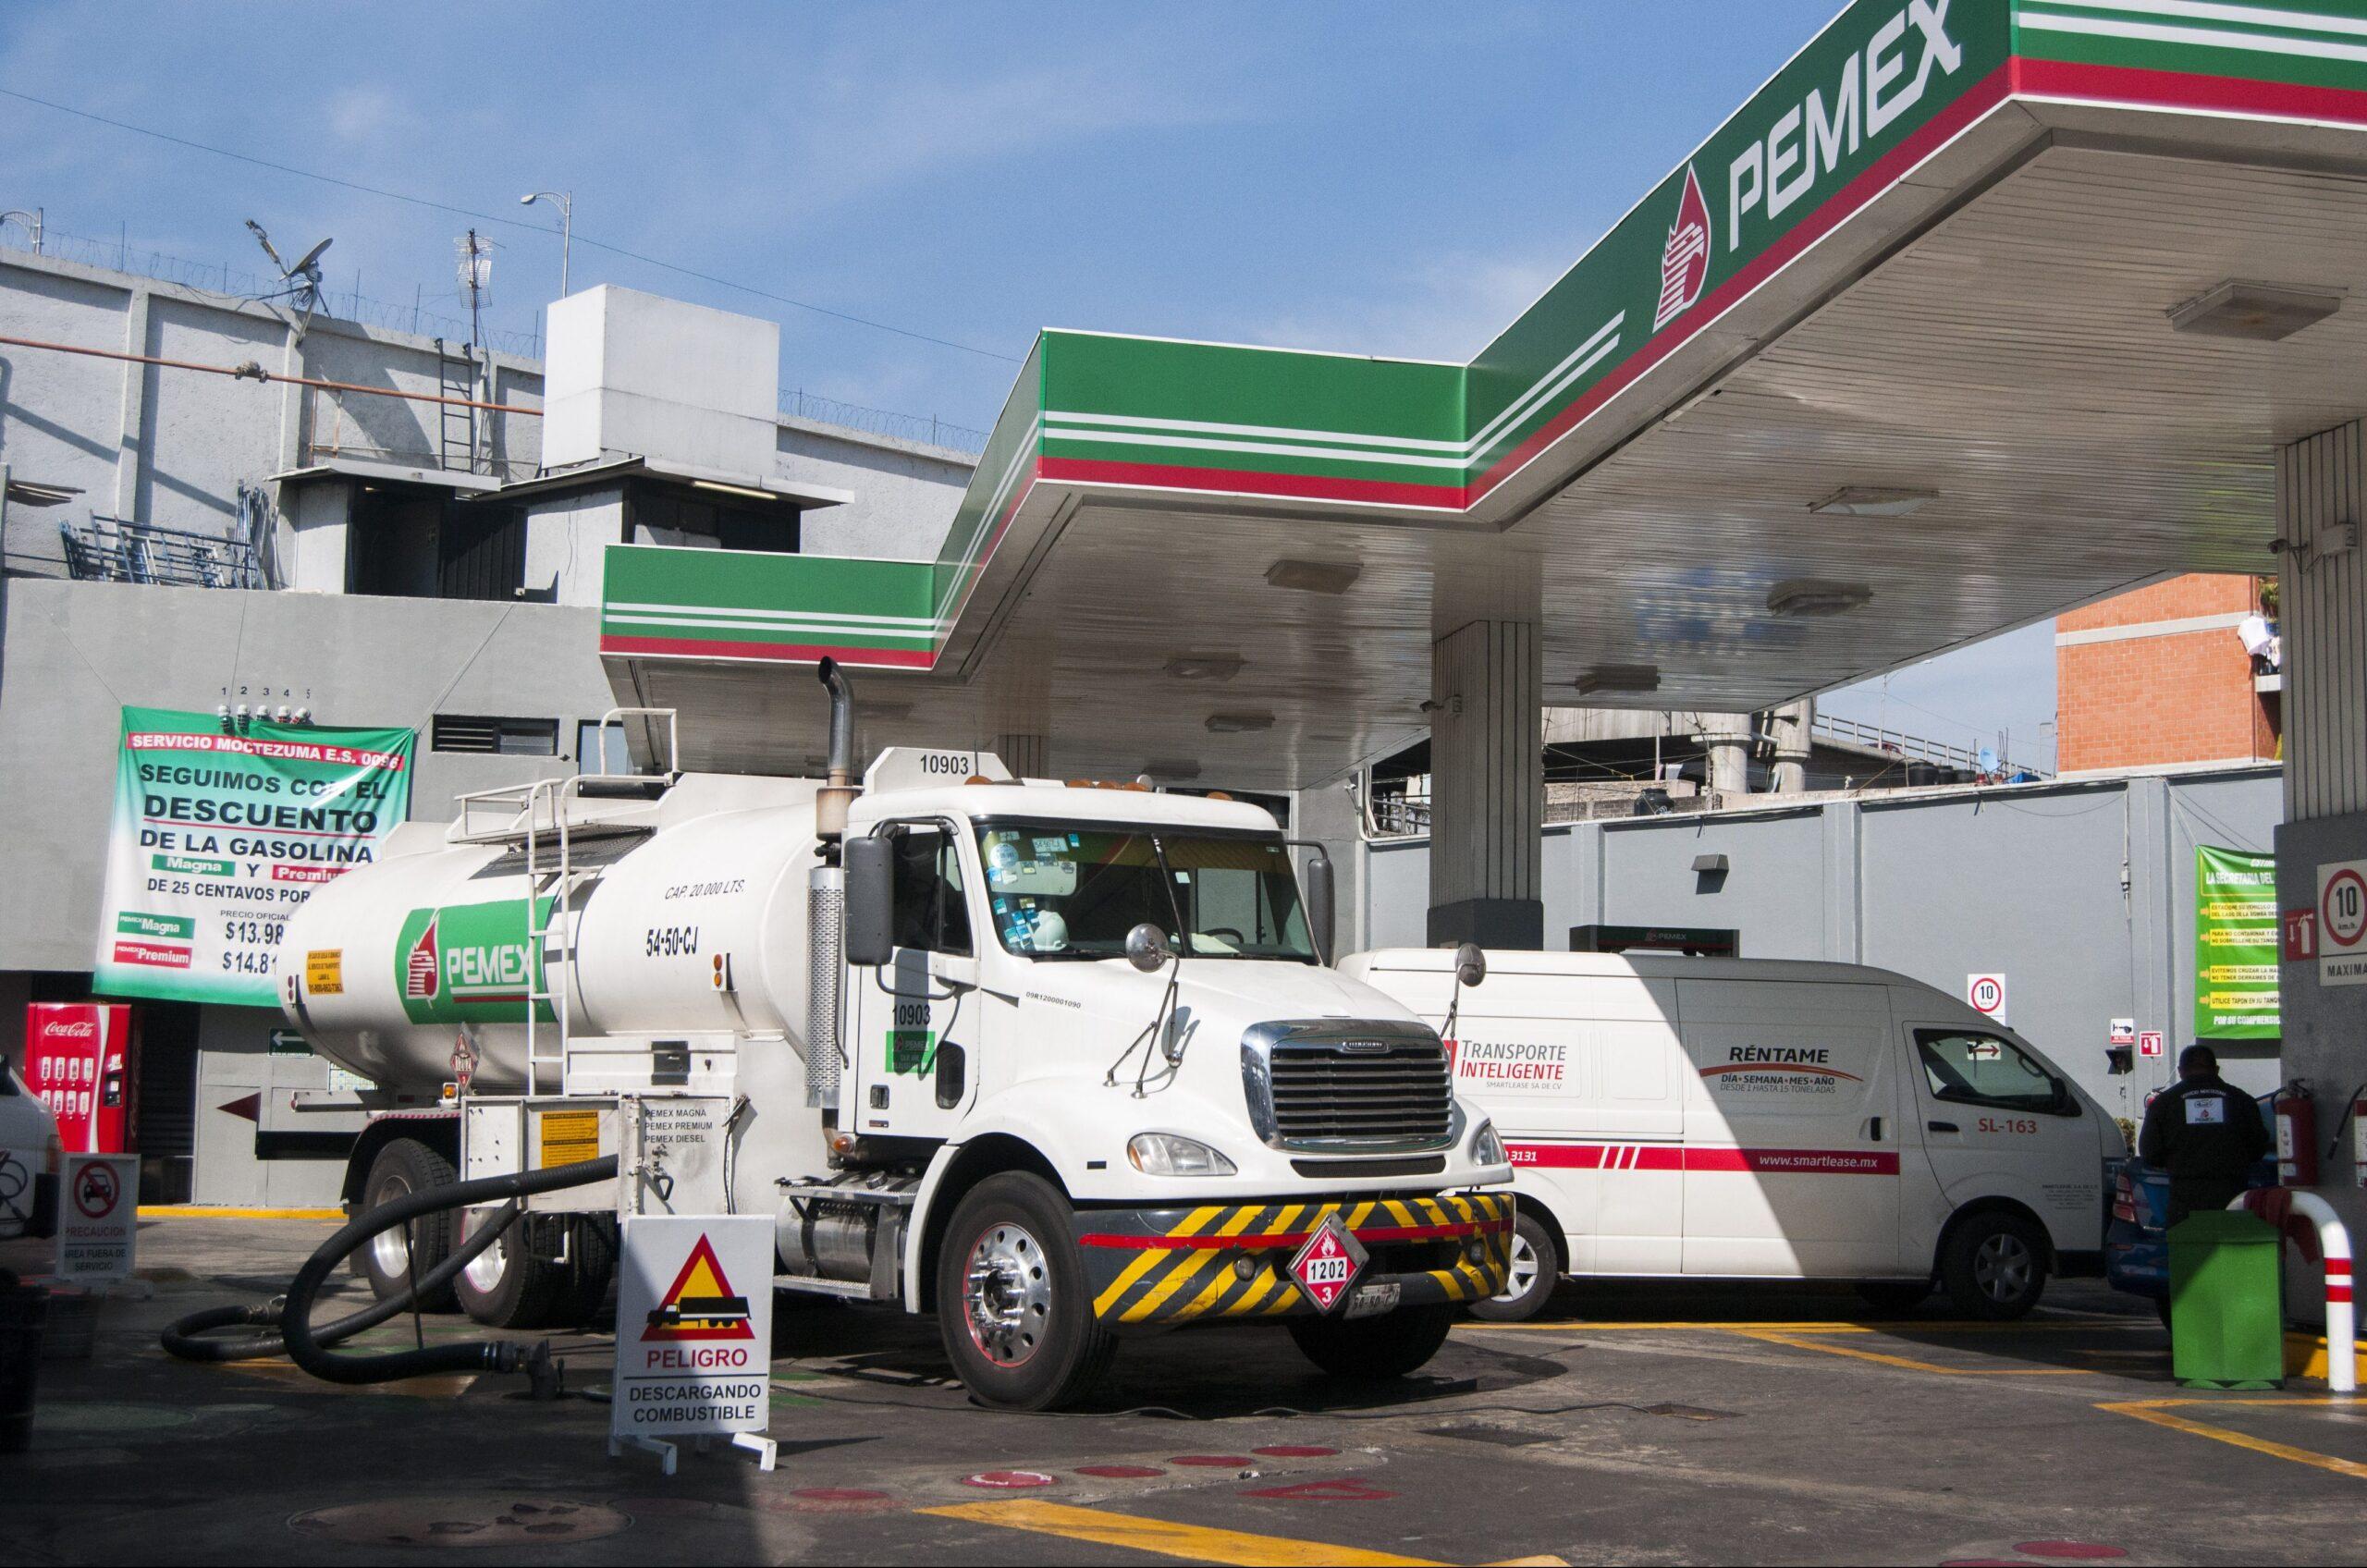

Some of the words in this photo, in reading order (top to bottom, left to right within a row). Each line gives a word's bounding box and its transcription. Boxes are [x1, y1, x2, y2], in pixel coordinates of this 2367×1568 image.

[1729, 0, 1962, 253] PEMEX
[240, 686, 248, 695] 2
[263, 687, 270, 696] 3
[283, 689, 290, 697] 4
[132, 734, 212, 750] SERVICIO
[215, 738, 321, 759] MOCTEZUMA
[325, 748, 357, 764] E.S.
[920, 754, 969, 775] 10903
[141, 764, 281, 793] SEGUIMOS
[356, 780, 386, 799] EL
[143, 794, 378, 834] DESCUENTO
[140, 828, 178, 850] DE
[185, 834, 219, 854] LA
[229, 837, 374, 864] GASOLINA
[166, 856, 223, 874] Magna
[246, 864, 261, 877] Y
[2206, 872, 2215, 884] LA
[2216, 872, 2262, 885] SECRETARIA
[147, 878, 166, 892] DE
[172, 880, 190, 895] 25
[194, 883, 275, 901] CENTAVOS
[280, 888, 311, 903] POR
[665, 886, 688, 900] CAP.
[2336, 886, 2357, 918] 10
[220, 910, 254, 919] PRECIO
[256, 912, 291, 921] OFICIAL
[141, 918, 180, 936] Magna
[646, 926, 699, 957] 54-50-CJ
[138, 948, 190, 963] Premium
[447, 944, 533, 985] PEMEX
[1981, 986, 1993, 999] 10
[891, 1004, 931, 1025] 10903
[1462, 1039, 1567, 1061] TRANSPORTE
[1729, 1044, 1830, 1063] RÉNTAME
[1460, 1059, 1564, 1081] INTELIGENTE
[1486, 1081, 1529, 1089] SMARTLEASE
[1721, 1084, 1745, 1092] DESDE
[1791, 1085, 1835, 1094] TONELADAS
[644, 1109, 674, 1118] PEMEX
[676, 1109, 706, 1117] MAGNA
[644, 1121, 673, 1131] PEMEX
[676, 1121, 713, 1130] PREMIUM
[1978, 1118, 2037, 1134] SL-163
[644, 1134, 674, 1144] PEMEX
[676, 1134, 705, 1143] DIESEL
[1510, 1150, 1538, 1162] 3131
[1760, 1155, 1878, 1169] www.smartlease.mx
[1311, 1260, 1344, 1280] 1202
[1321, 1286, 1332, 1304] 3
[647, 1348, 748, 1369] PELIGRO
[630, 1383, 762, 1403] DESCARGANDO
[633, 1404, 755, 1424] COMBUSTIBLE
